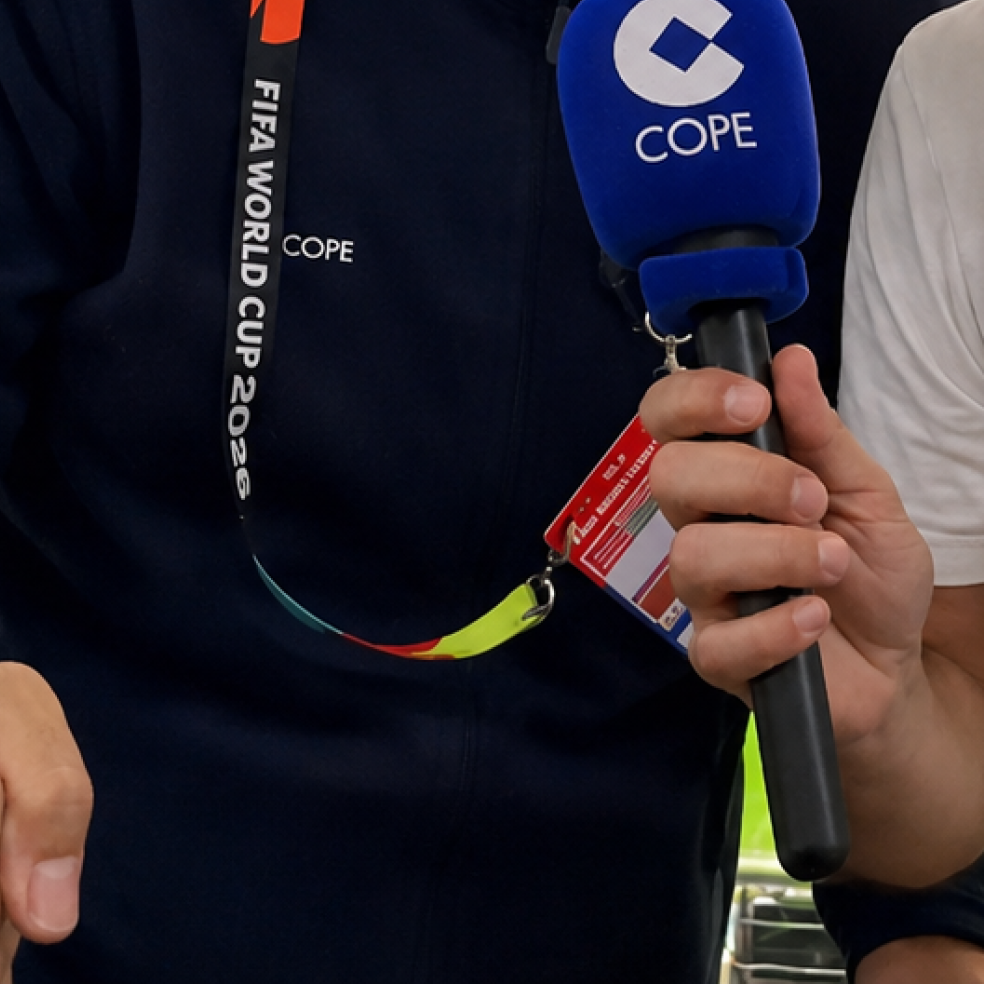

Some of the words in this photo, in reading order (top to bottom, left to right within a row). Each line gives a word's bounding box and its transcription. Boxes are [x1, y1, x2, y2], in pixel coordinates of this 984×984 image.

[249, 79, 280, 152] FIFA
[635, 112, 757, 162] COPE
[241, 161, 273, 287] WORLD
[283, 235, 353, 262] COPE
[236, 297, 265, 368] CUP
[228, 375, 256, 500] 2026
